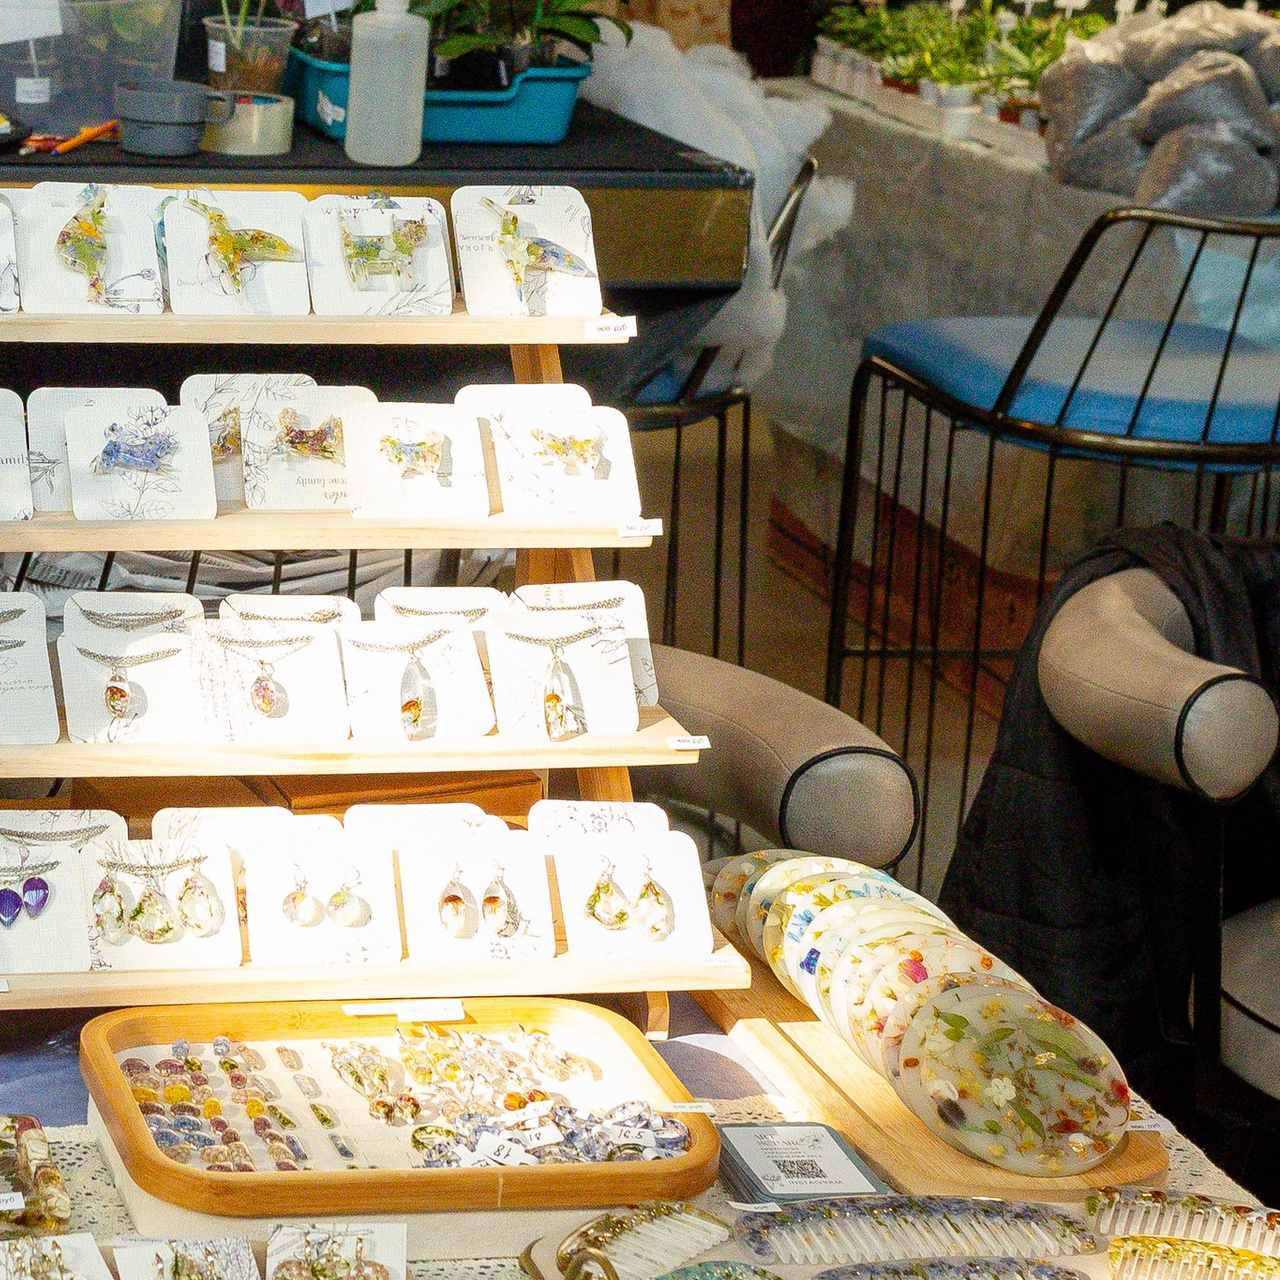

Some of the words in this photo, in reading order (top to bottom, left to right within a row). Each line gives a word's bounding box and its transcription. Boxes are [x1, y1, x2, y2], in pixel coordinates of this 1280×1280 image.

[295, 474, 326, 488] family
[617, 1128, 647, 1141] 16.5
[492, 1143, 513, 1160] 18
